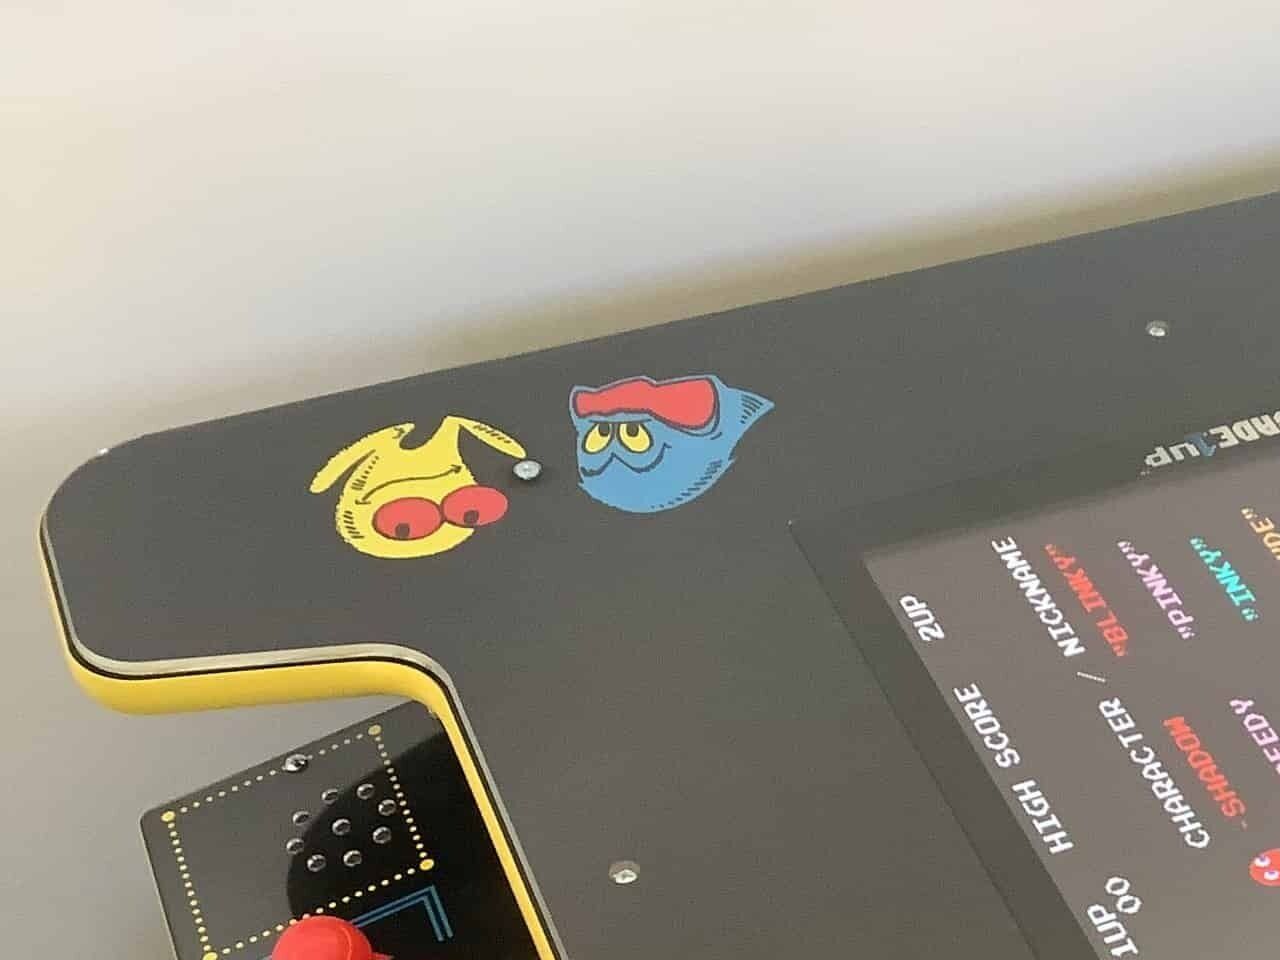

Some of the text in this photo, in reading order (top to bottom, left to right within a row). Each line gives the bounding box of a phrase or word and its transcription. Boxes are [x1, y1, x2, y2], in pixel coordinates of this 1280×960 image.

[991, 536, 1086, 657] NICKNAME
[900, 594, 1139, 957] 1UP HIGH SCORE 2UP
[1099, 697, 1210, 849] CHARACTER
[1105, 876, 1142, 915] 00
